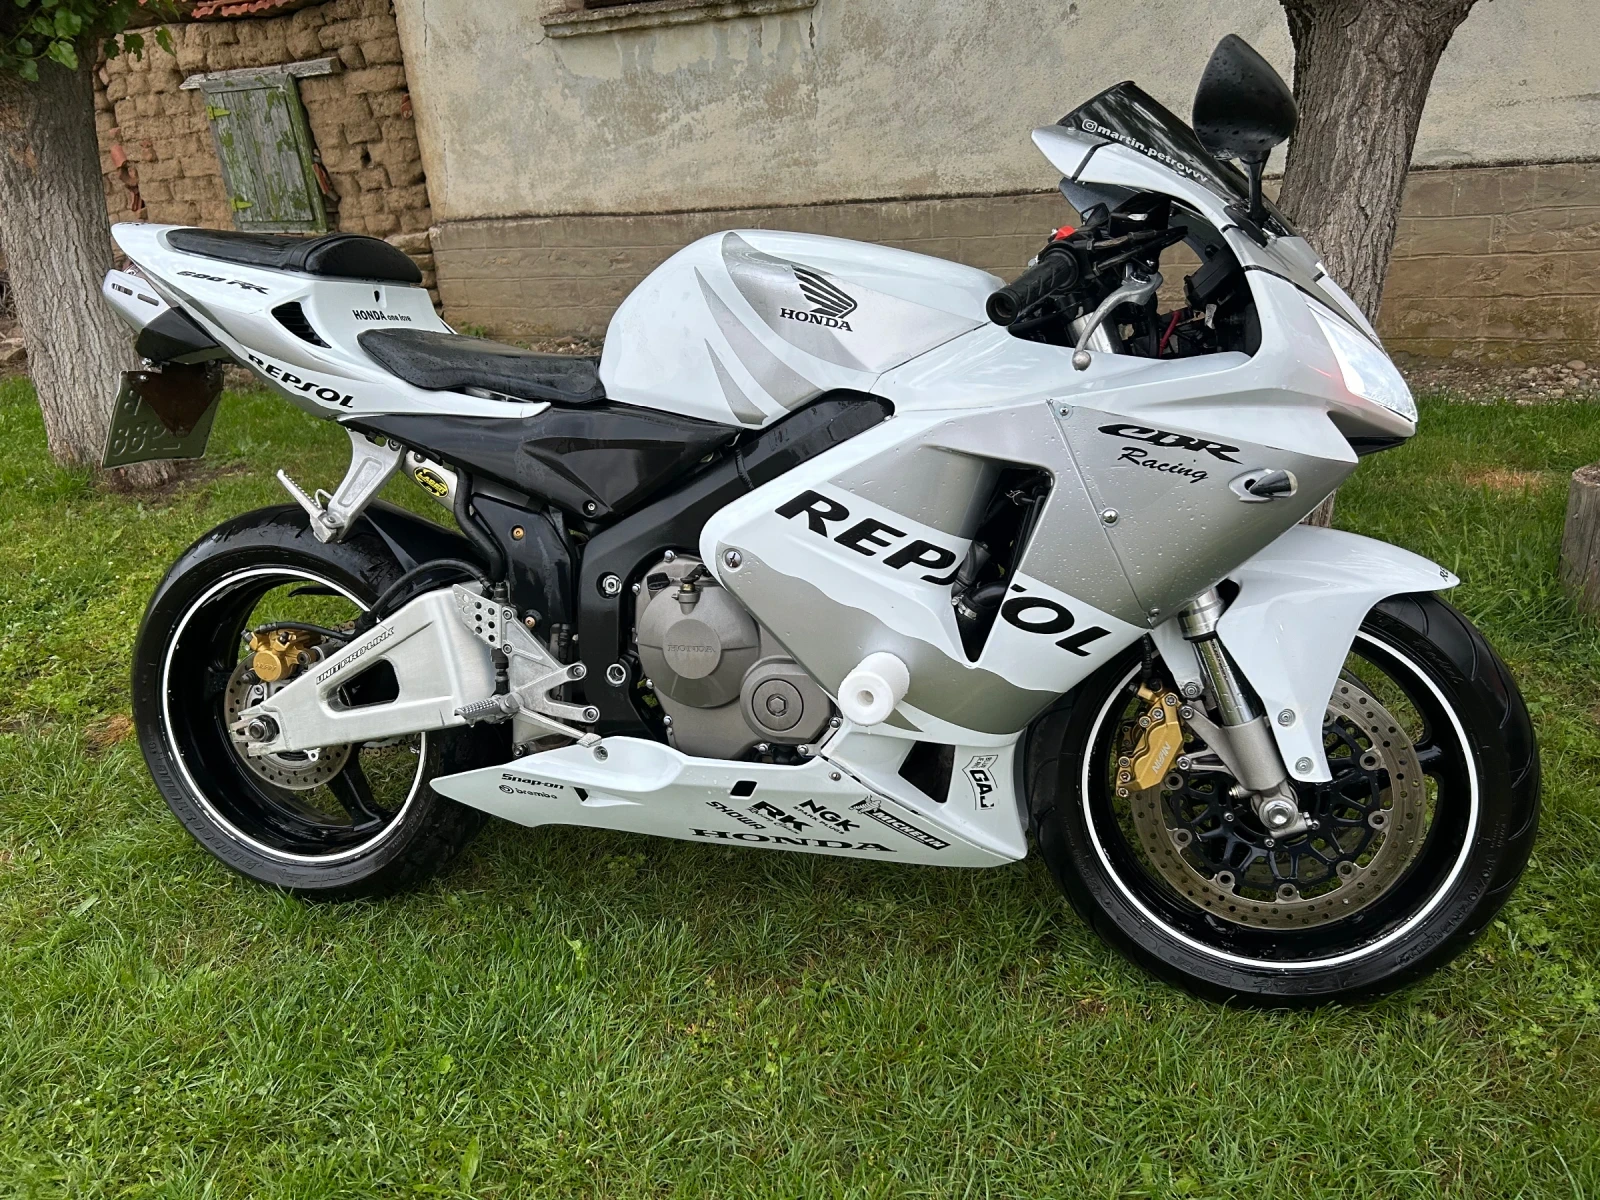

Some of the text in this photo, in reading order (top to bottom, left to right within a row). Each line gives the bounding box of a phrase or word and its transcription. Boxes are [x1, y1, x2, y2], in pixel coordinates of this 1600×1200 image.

[352, 309, 387, 321] HONDA
[780, 307, 853, 332] HONDA
[248, 353, 354, 408] REPSOL
[1097, 423, 1244, 465] CBR
[1117, 446, 1209, 483] Racing
[667, 644, 716, 653] HONDA
[316, 662, 340, 686] UNIT
[501, 773, 564, 790] Snap-on
[705, 800, 767, 830] SHOWA
[751, 800, 794, 832] RK
[798, 799, 860, 832] NGK
[872, 810, 946, 848] MICHELIN
[689, 827, 898, 853] HONDA
